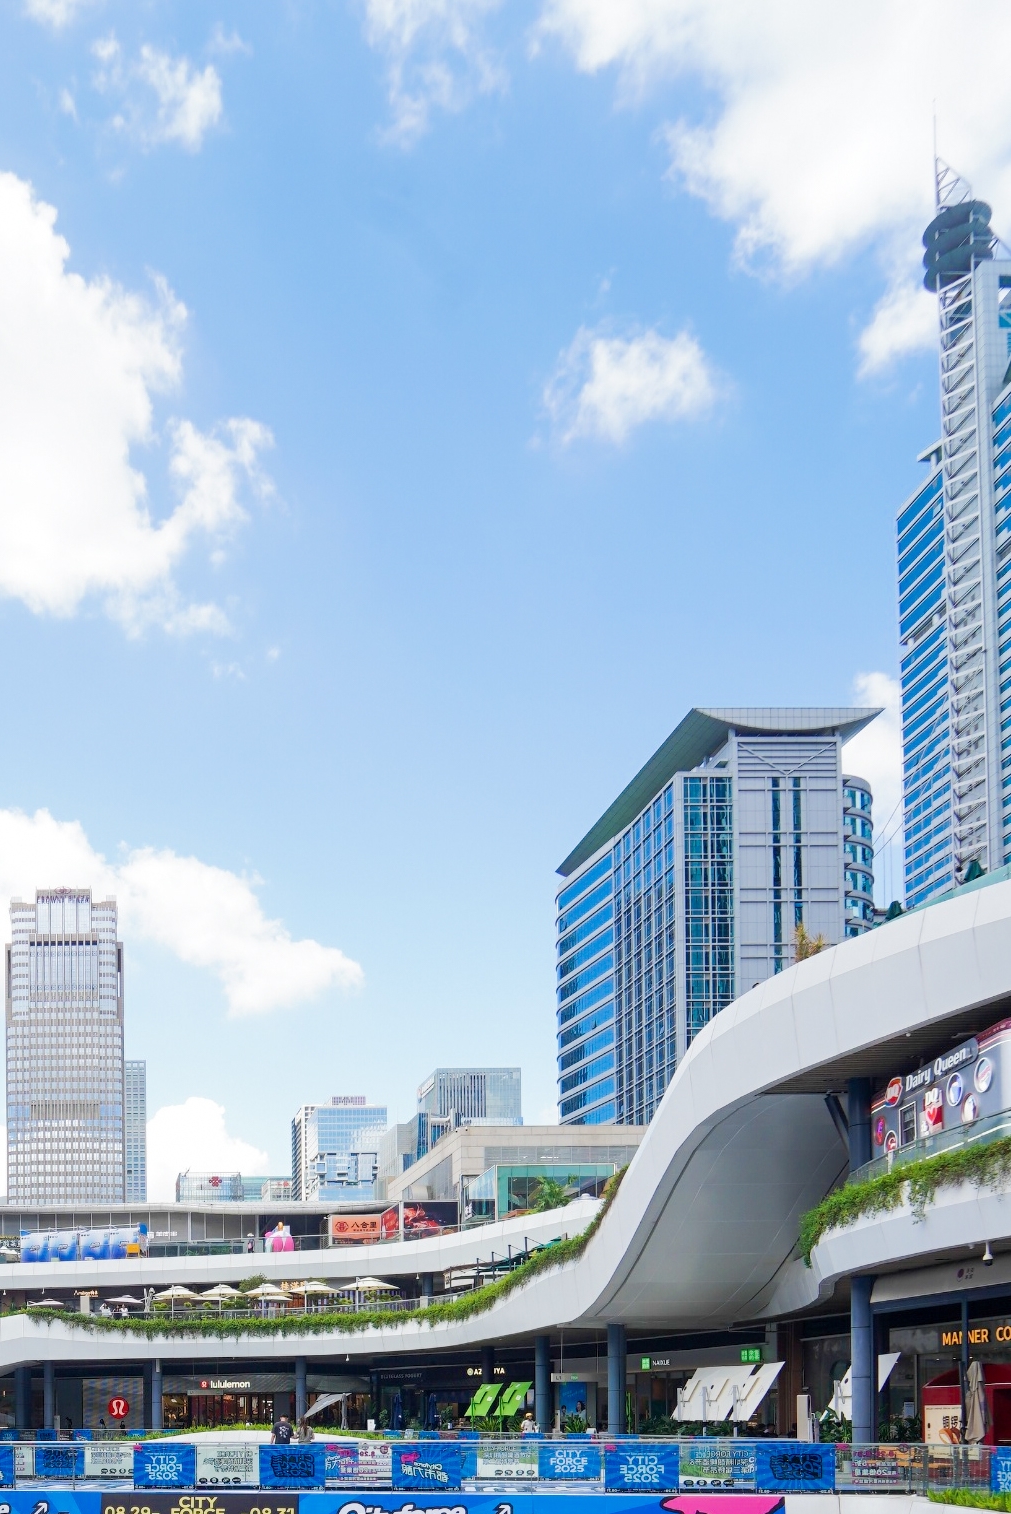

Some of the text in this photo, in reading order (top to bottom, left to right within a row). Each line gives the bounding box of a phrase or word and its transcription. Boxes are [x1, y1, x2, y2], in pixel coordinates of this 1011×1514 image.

[906, 1047, 966, 1093] Dairy Queen
[211, 1379, 250, 1389] lululemon
[555, 1450, 581, 1458] CITY
[550, 1457, 588, 1465] FORCE
[554, 1464, 585, 1473] 2025
[178, 1496, 217, 1509] CITY
